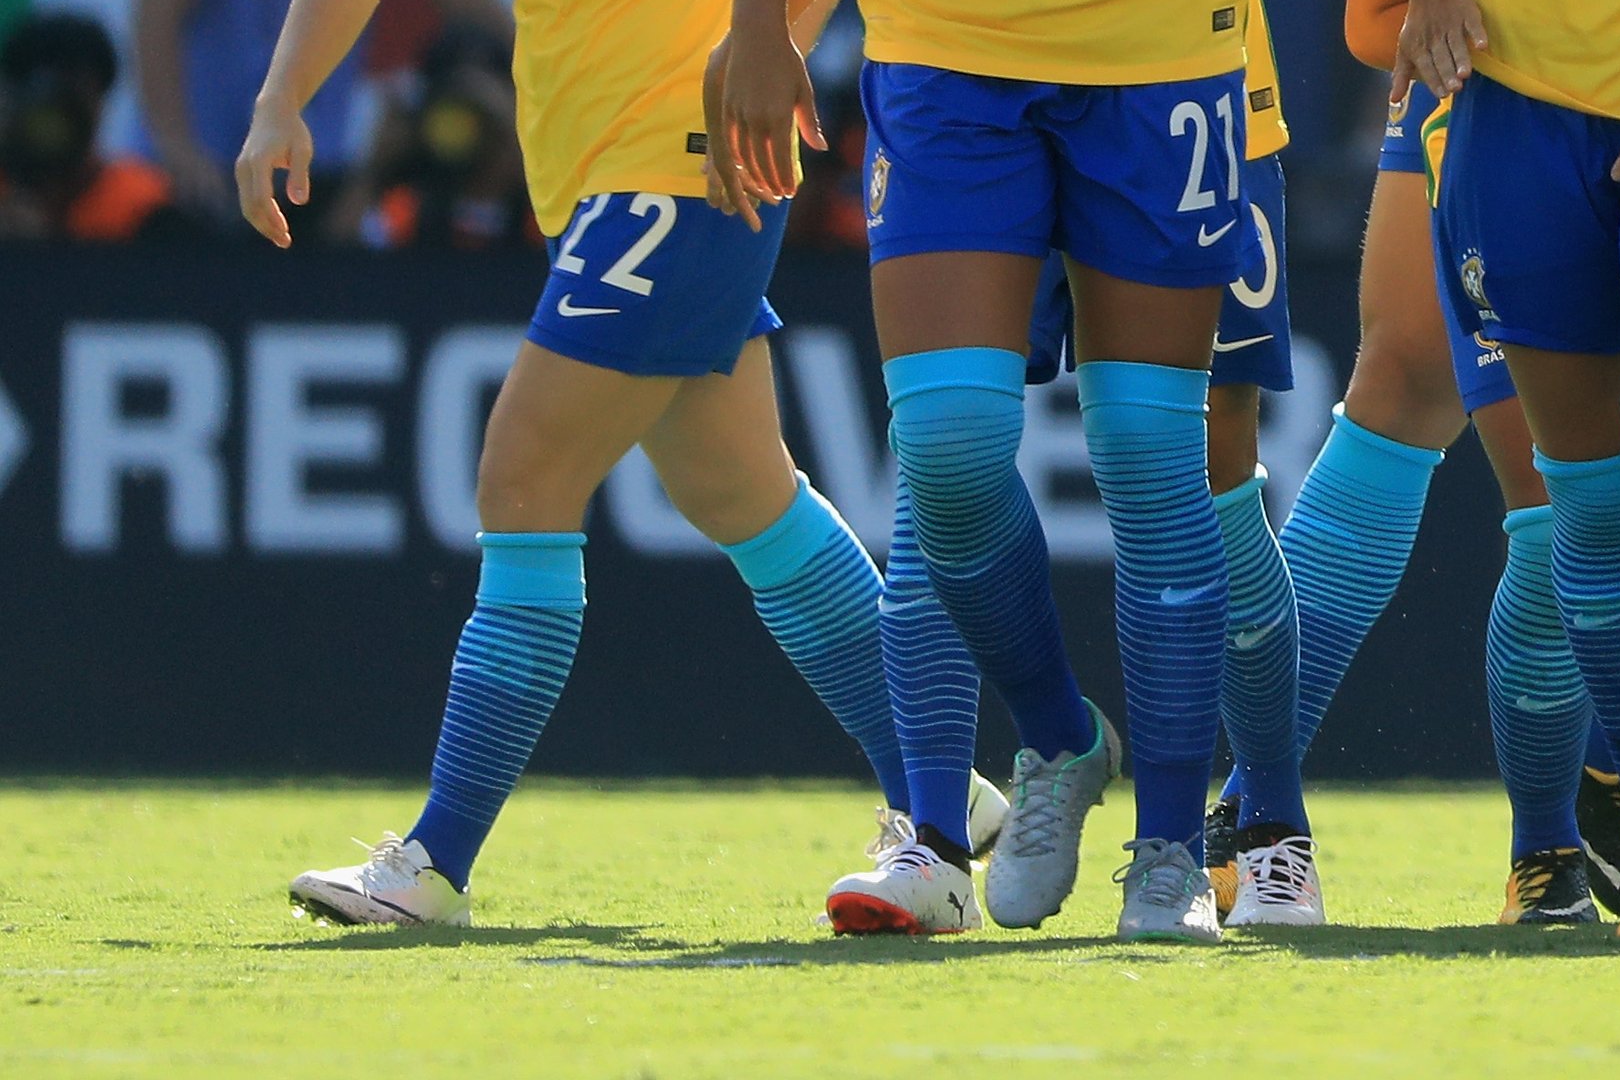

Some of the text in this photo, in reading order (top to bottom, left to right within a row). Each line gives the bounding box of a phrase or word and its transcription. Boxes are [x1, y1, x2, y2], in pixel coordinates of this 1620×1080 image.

[1169, 92, 1239, 212] 21
[555, 192, 677, 296] 22
[1477, 349, 1505, 367] BRAS
